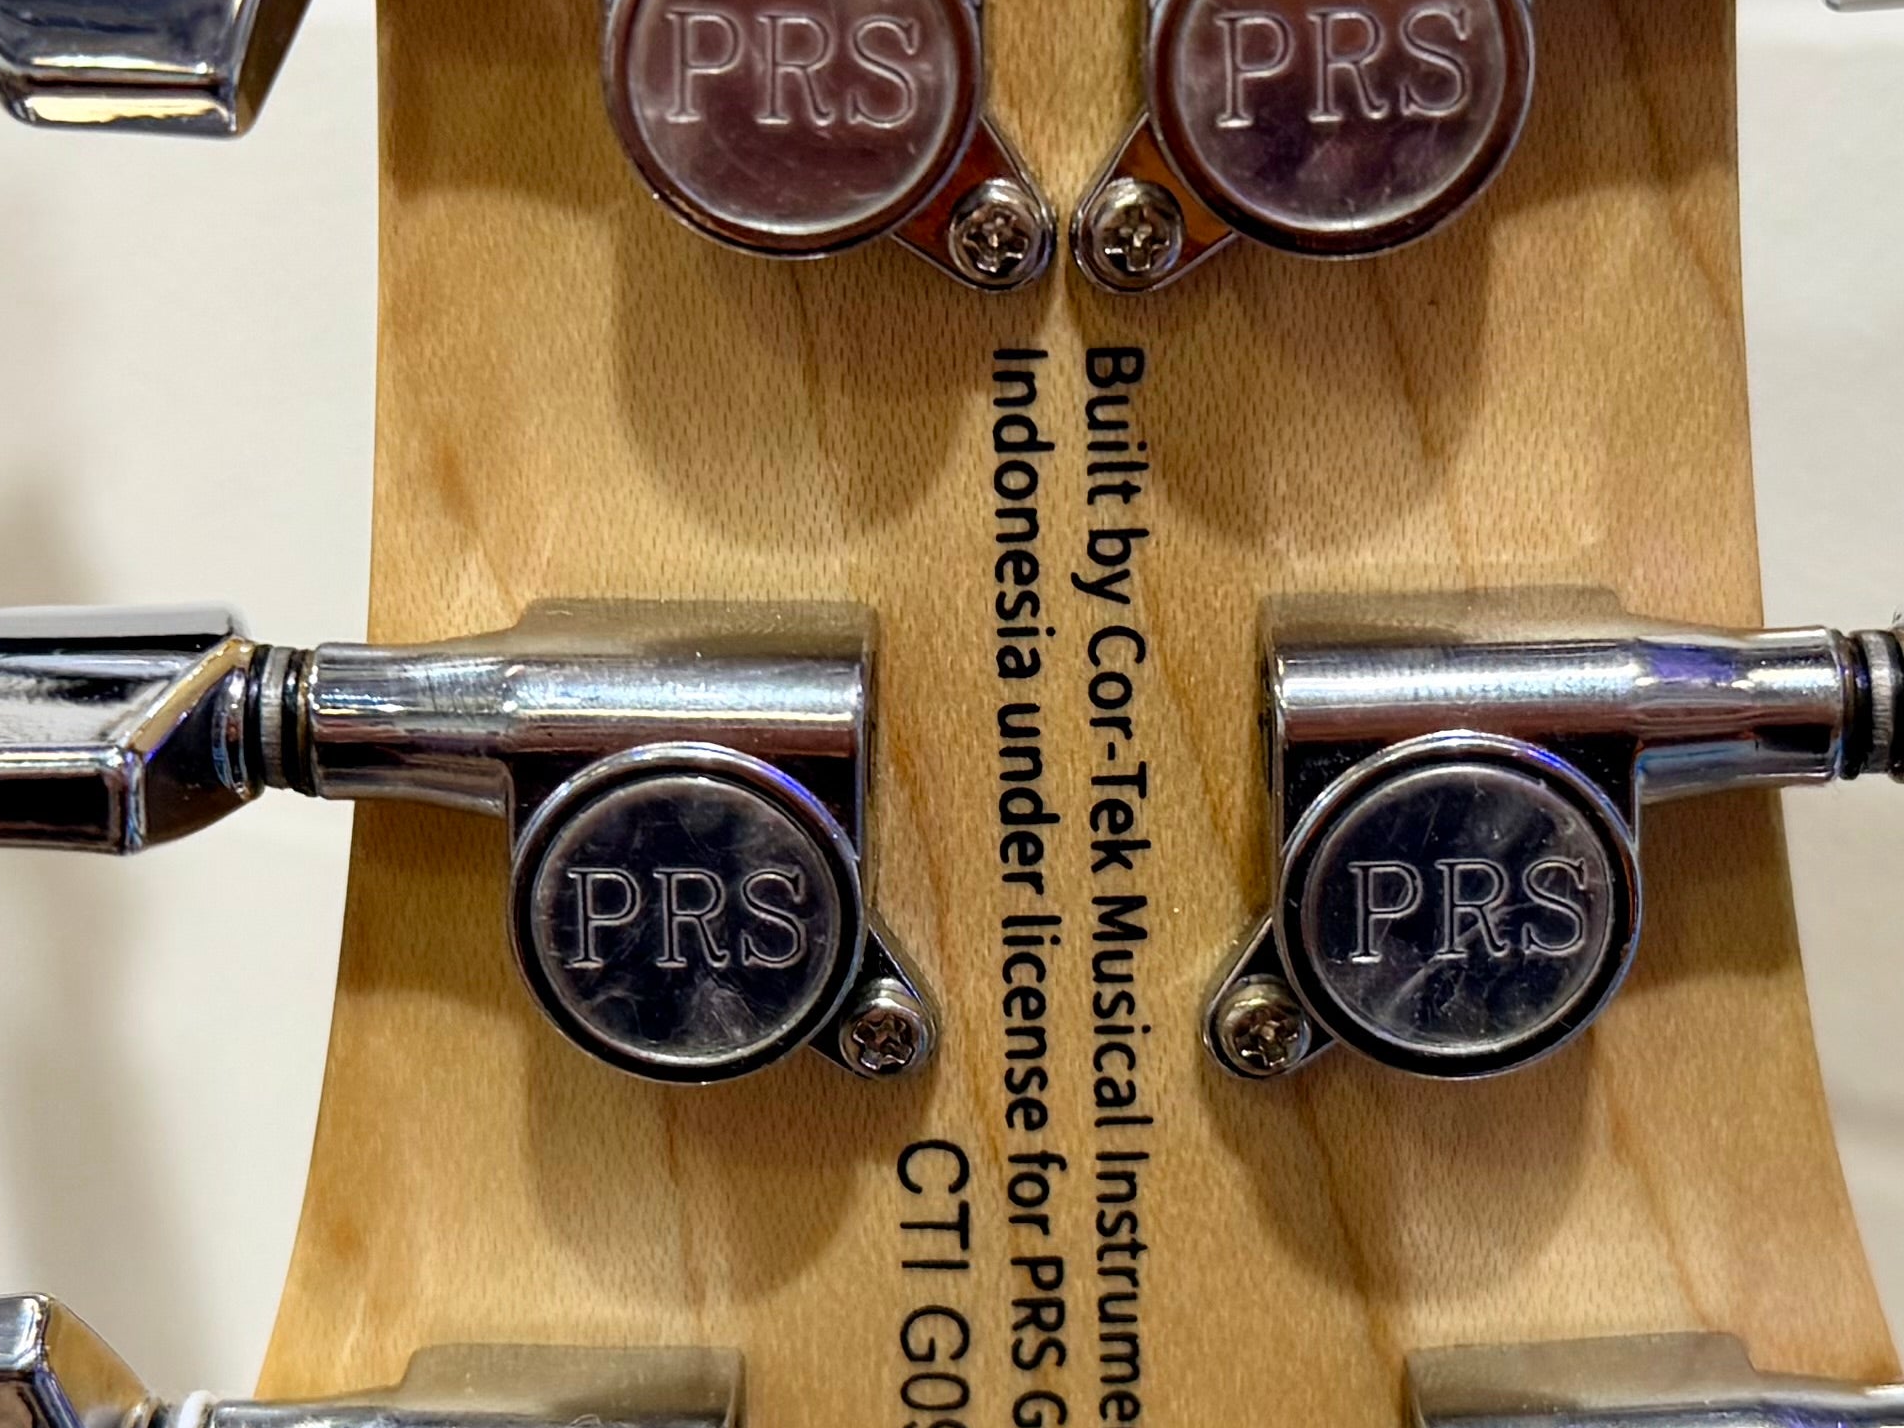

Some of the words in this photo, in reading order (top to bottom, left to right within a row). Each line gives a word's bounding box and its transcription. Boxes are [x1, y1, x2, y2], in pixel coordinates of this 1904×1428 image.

[661, 7, 922, 132] PRS
[1213, 4, 1472, 130] PRS
[1085, 345, 1150, 506] Built
[992, 347, 1056, 680] Indonesia
[1070, 527, 1150, 605] by
[996, 702, 1061, 897] under
[1087, 625, 1152, 875] Cor-Tek
[568, 866, 807, 969] PRS
[1350, 856, 1590, 962] PRS
[1001, 914, 1063, 1132] license
[1091, 894, 1154, 1129] Musical
[898, 1138, 971, 1271] CTI
[1006, 1149, 1068, 1237] for
[1009, 1255, 1068, 1372] PRS
